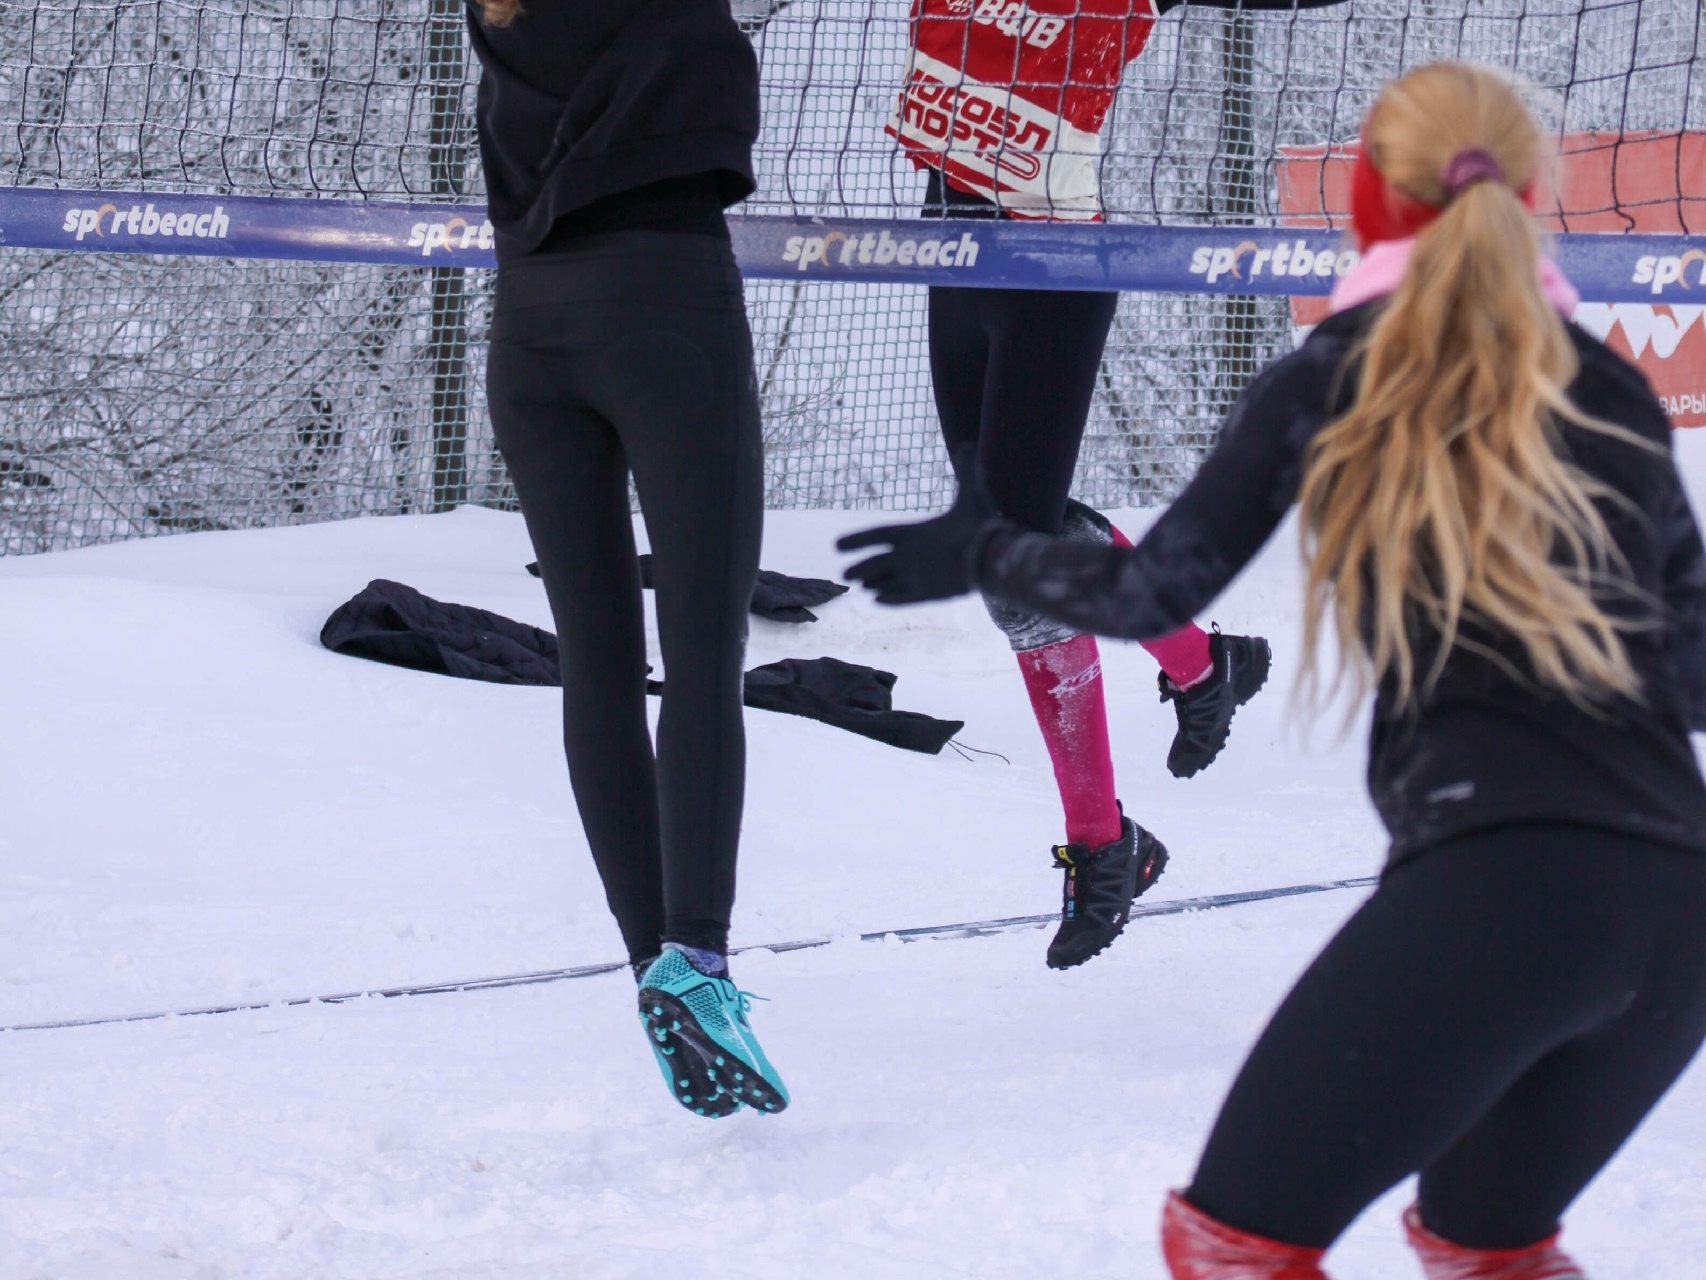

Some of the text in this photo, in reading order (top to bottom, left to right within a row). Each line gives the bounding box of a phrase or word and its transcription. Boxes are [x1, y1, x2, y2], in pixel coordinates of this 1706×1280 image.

[62, 203, 230, 241] sportbeach
[406, 218, 496, 256] sport
[782, 230, 979, 271] sportbeach
